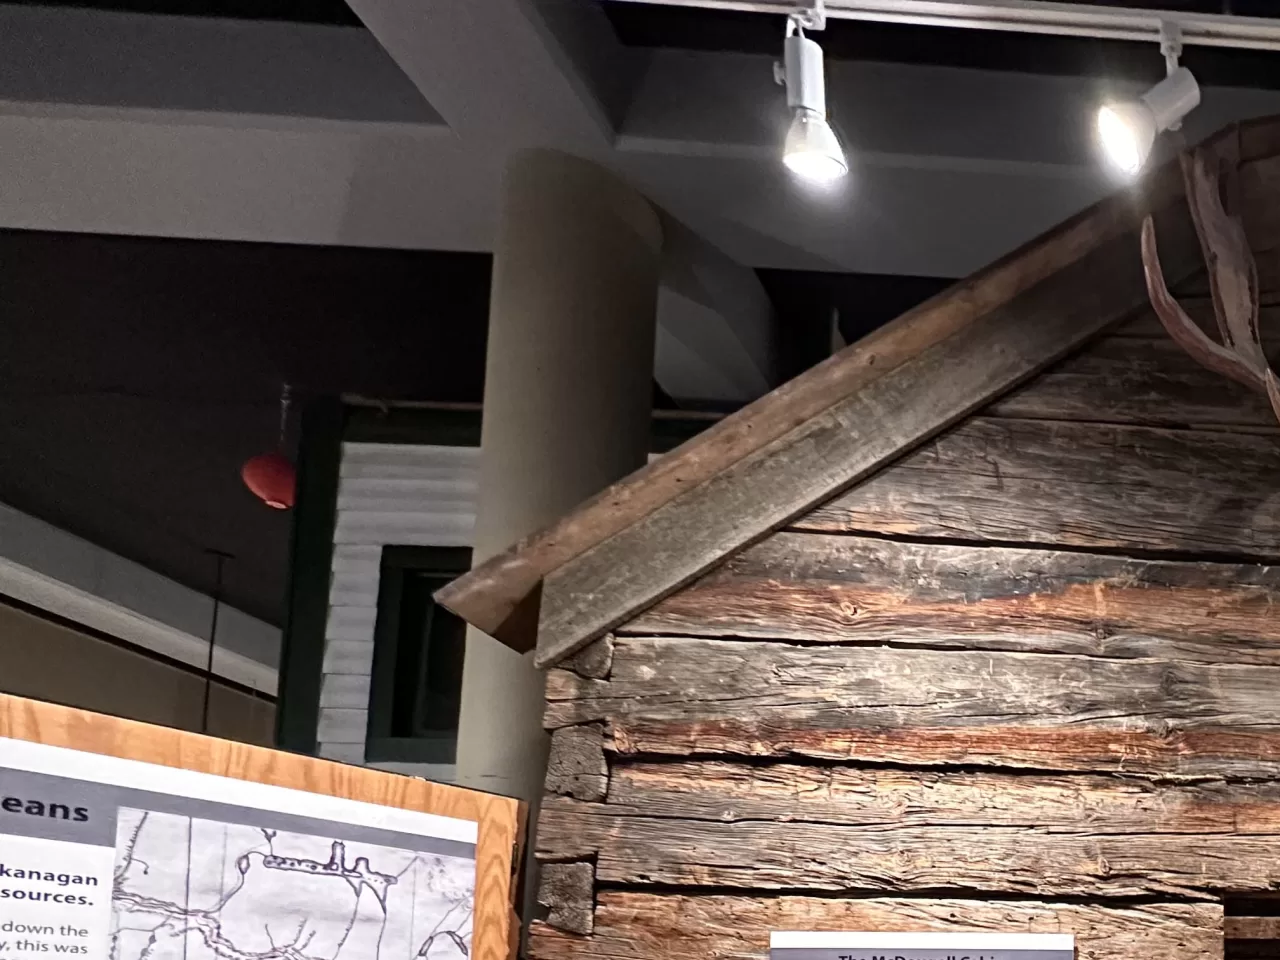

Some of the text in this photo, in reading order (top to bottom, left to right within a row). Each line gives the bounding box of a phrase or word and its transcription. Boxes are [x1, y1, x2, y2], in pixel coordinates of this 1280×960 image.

[0, 864, 98, 886] kanagan
[2, 921, 88, 937] down the
[16, 940, 88, 954] this was
